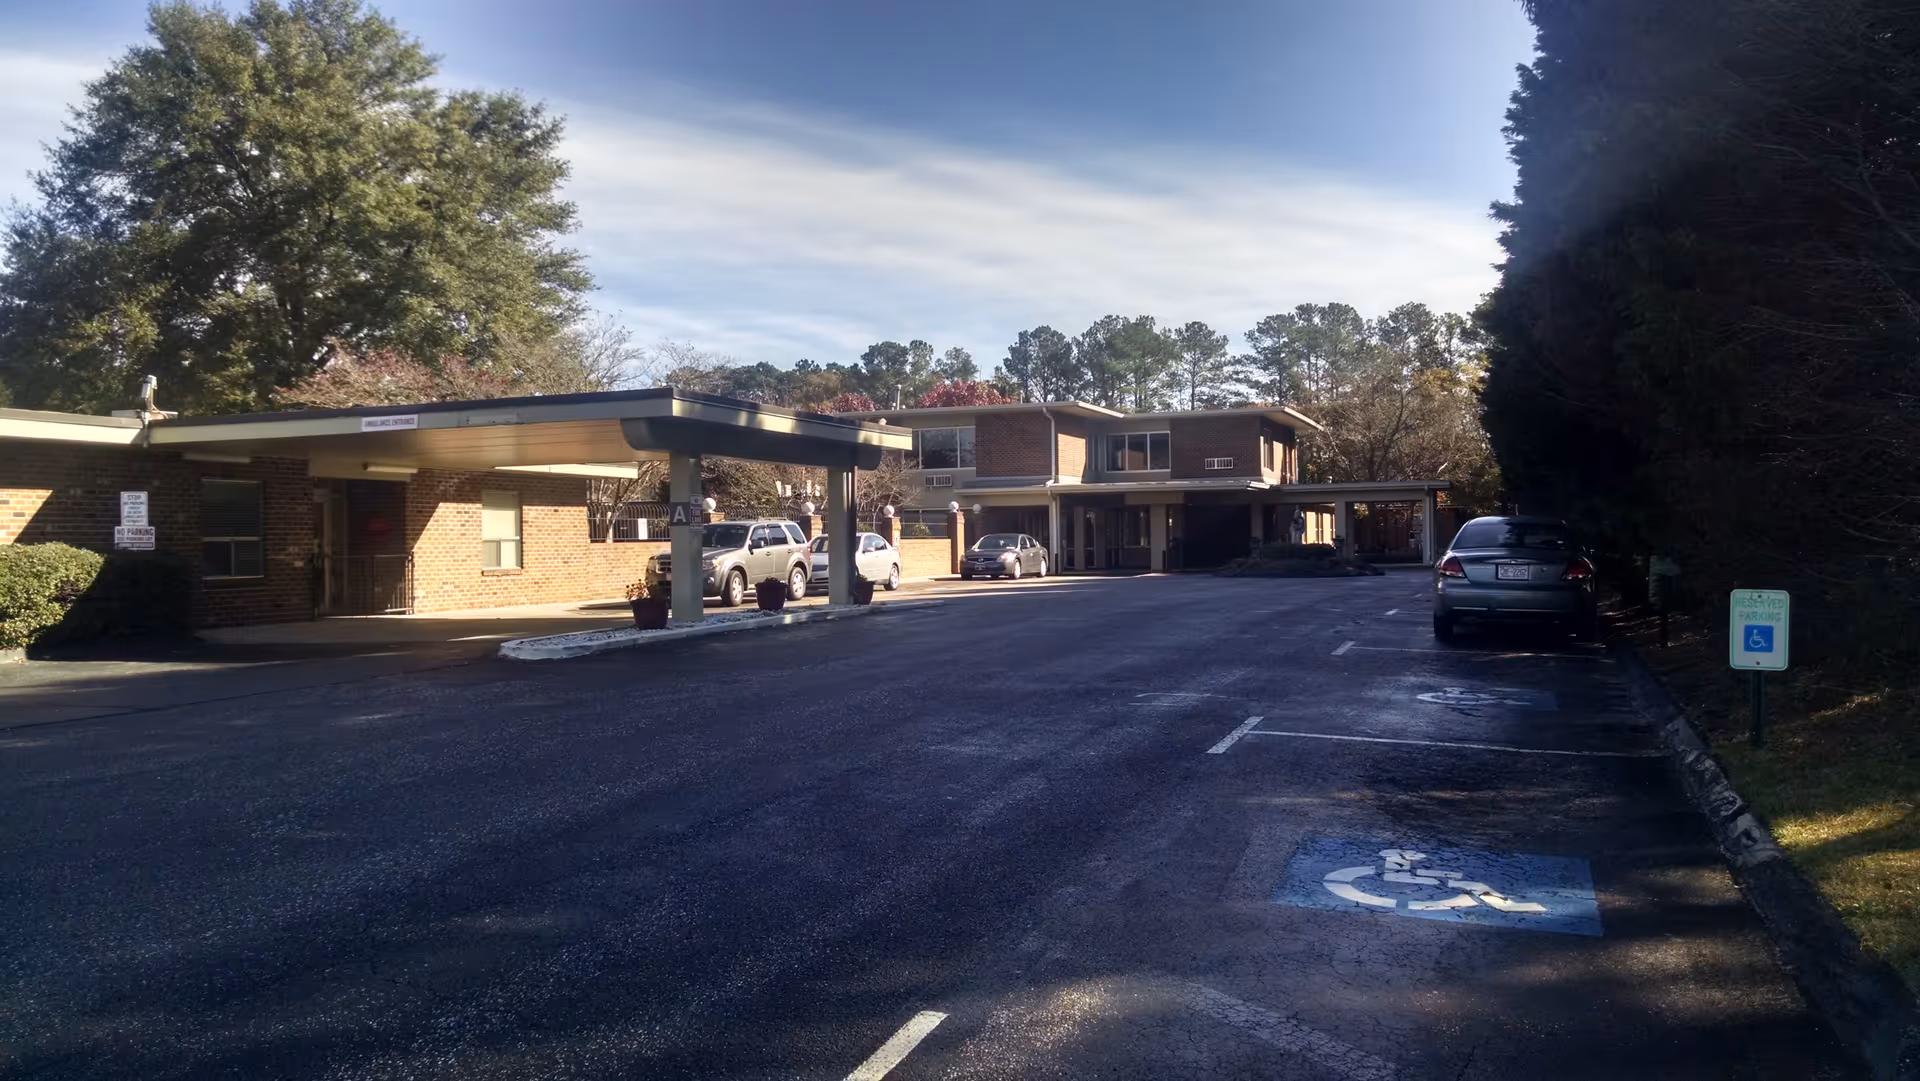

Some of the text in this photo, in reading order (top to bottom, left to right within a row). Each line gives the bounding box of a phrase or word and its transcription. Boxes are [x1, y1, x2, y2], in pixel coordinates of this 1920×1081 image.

[391, 417, 415, 426] ENTRANCE
[673, 505, 687, 523] A
[117, 527, 154, 537] NO PARKING
[1735, 598, 1785, 609] RESERVED
[1738, 610, 1783, 622] PARKING
